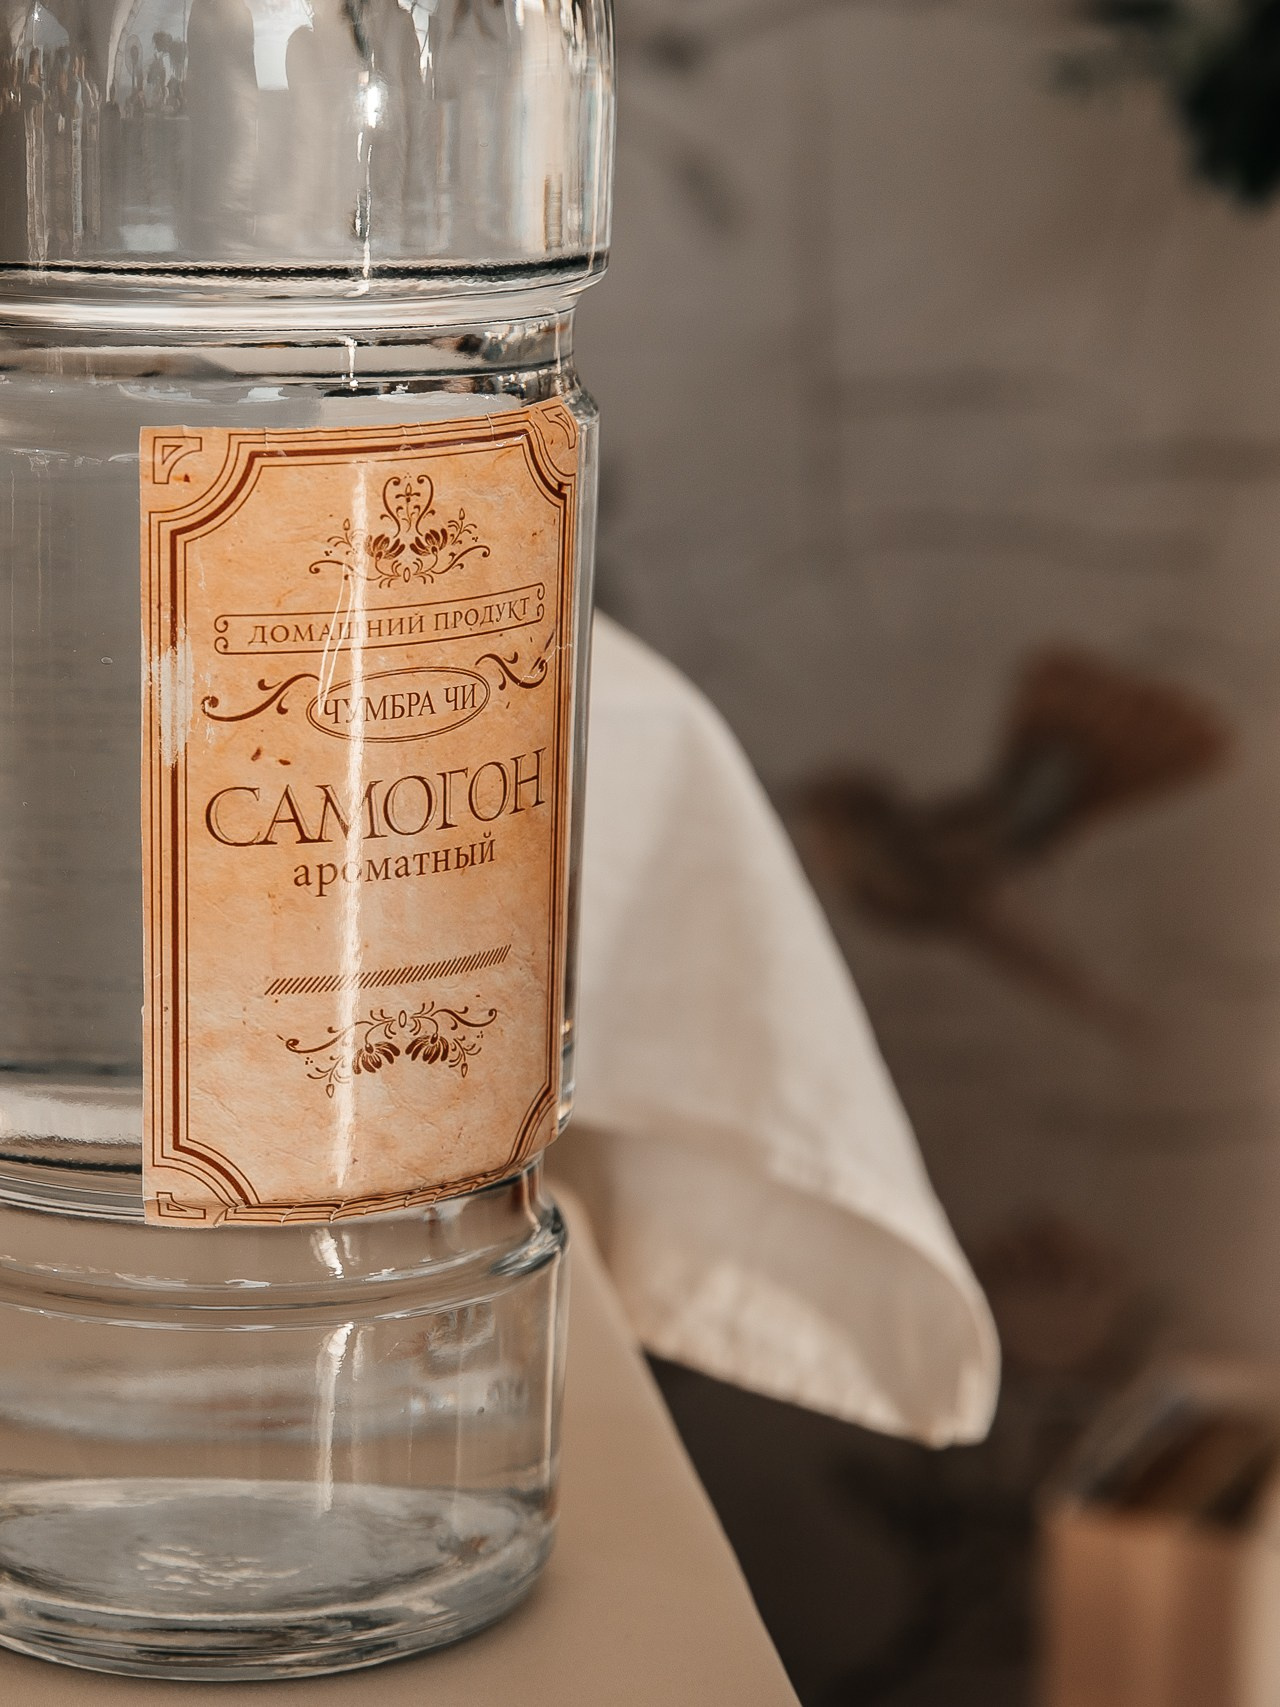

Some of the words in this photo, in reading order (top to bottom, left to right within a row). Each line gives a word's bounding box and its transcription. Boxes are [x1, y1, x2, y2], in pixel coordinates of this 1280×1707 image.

[434, 597, 531, 632] ПРОДУКТ
[323, 691, 436, 725] ЧУМБРА
[444, 683, 478, 713] ЧИ
[205, 747, 547, 847] САМОГОН
[293, 832, 496, 898] ароматный
